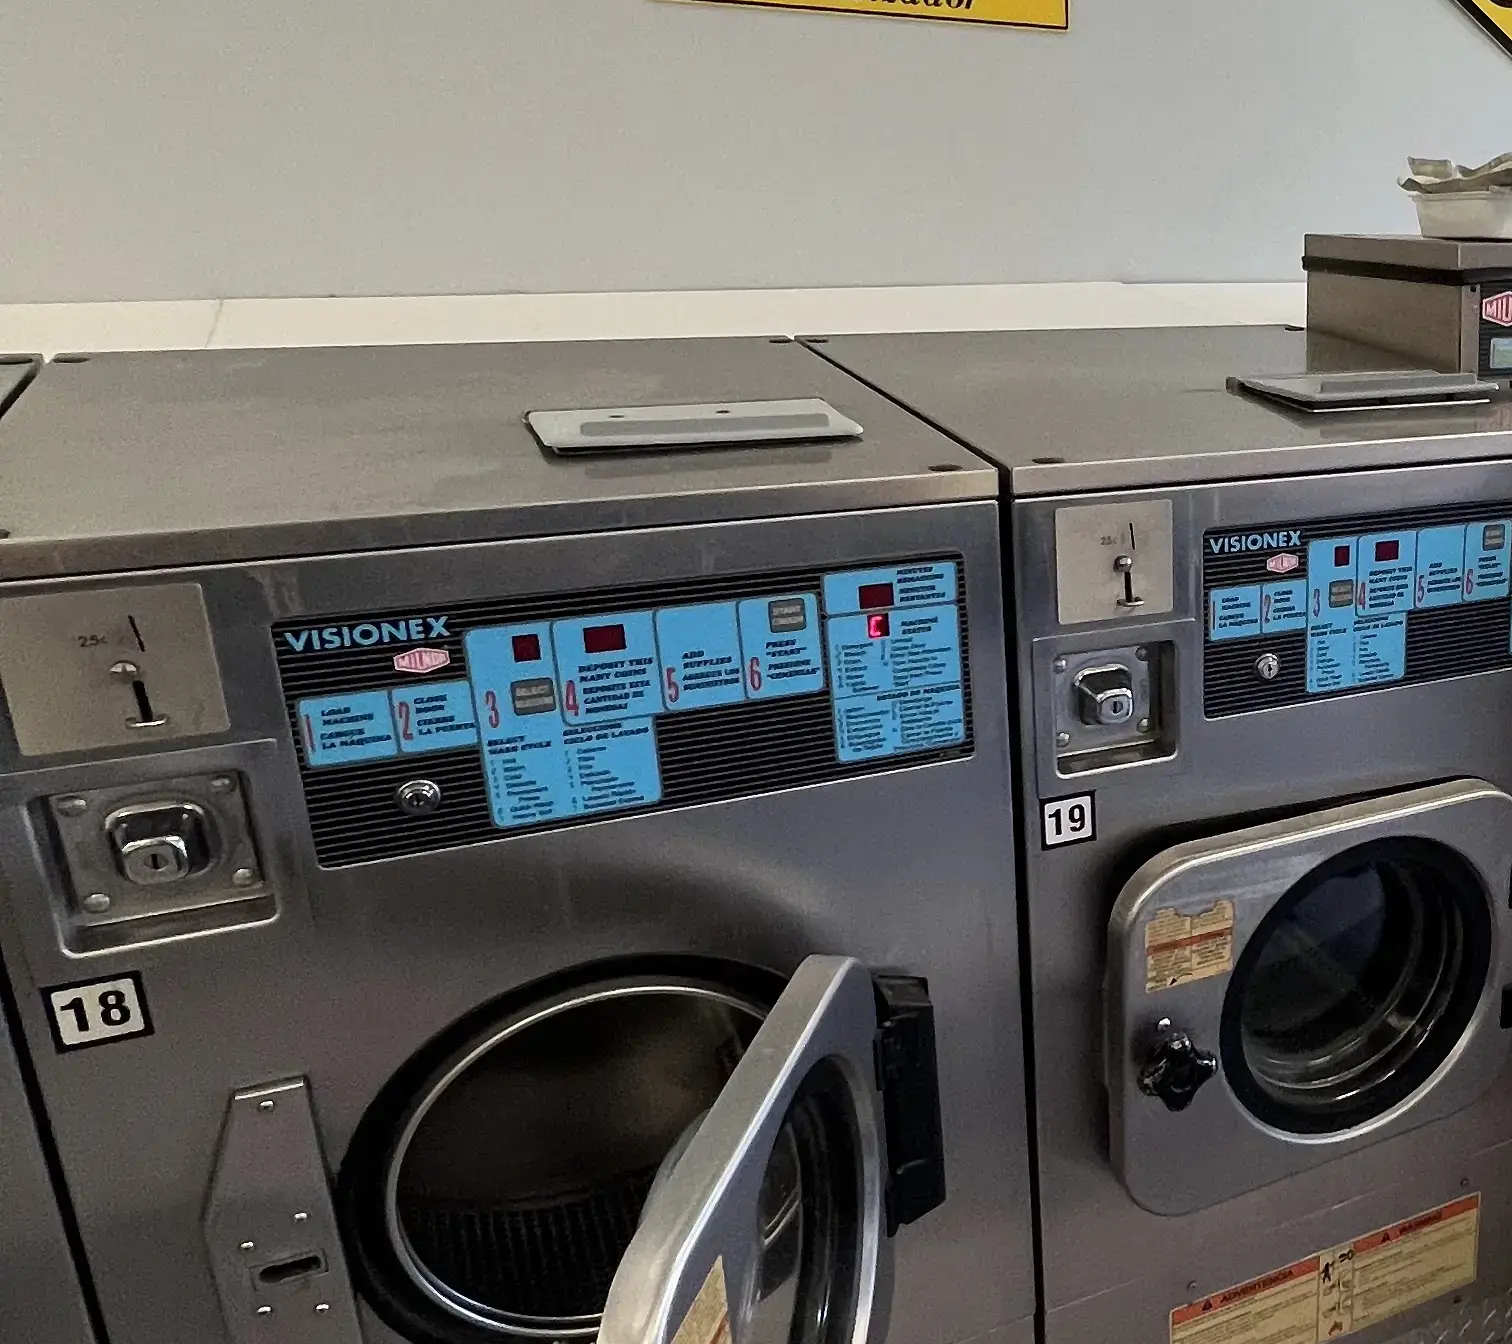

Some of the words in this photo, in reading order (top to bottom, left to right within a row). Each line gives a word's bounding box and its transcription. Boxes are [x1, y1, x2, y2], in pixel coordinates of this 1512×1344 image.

[1209, 530, 1302, 554] VISIONEX
[283, 615, 450, 652] VISIONEX
[665, 667, 680, 703] 5
[750, 656, 762, 691] 6
[485, 690, 500, 729] 3
[565, 679, 580, 717] 4
[398, 701, 414, 740] 2
[1048, 803, 1086, 837] 19
[60, 989, 132, 1034] 18
